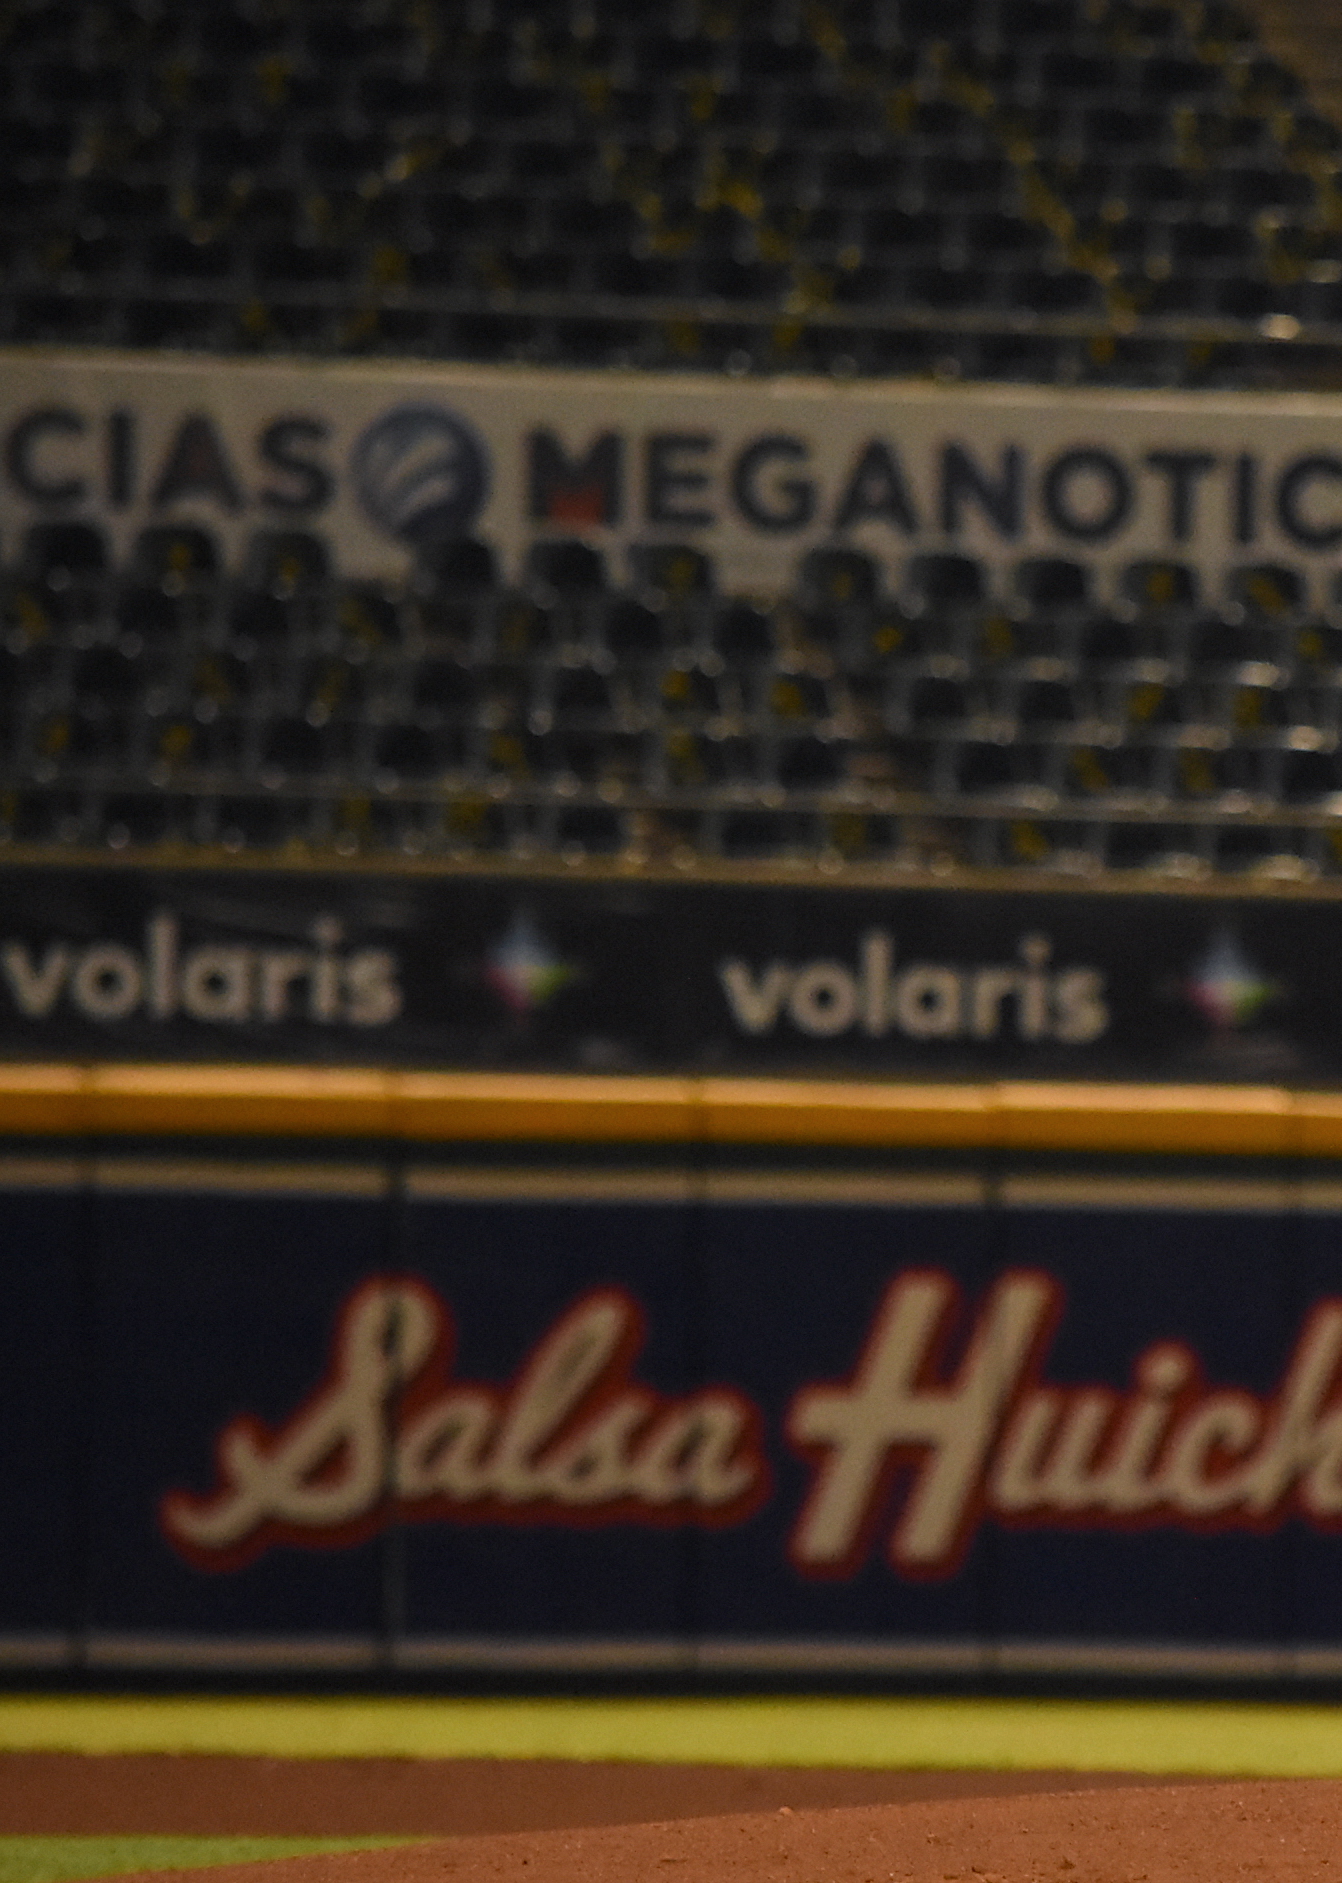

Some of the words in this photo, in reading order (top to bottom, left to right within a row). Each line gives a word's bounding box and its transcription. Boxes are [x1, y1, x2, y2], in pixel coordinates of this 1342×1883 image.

[3, 912, 400, 1026] volaris
[717, 927, 1109, 1043] volaris
[160, 1274, 771, 1572] Salsa
